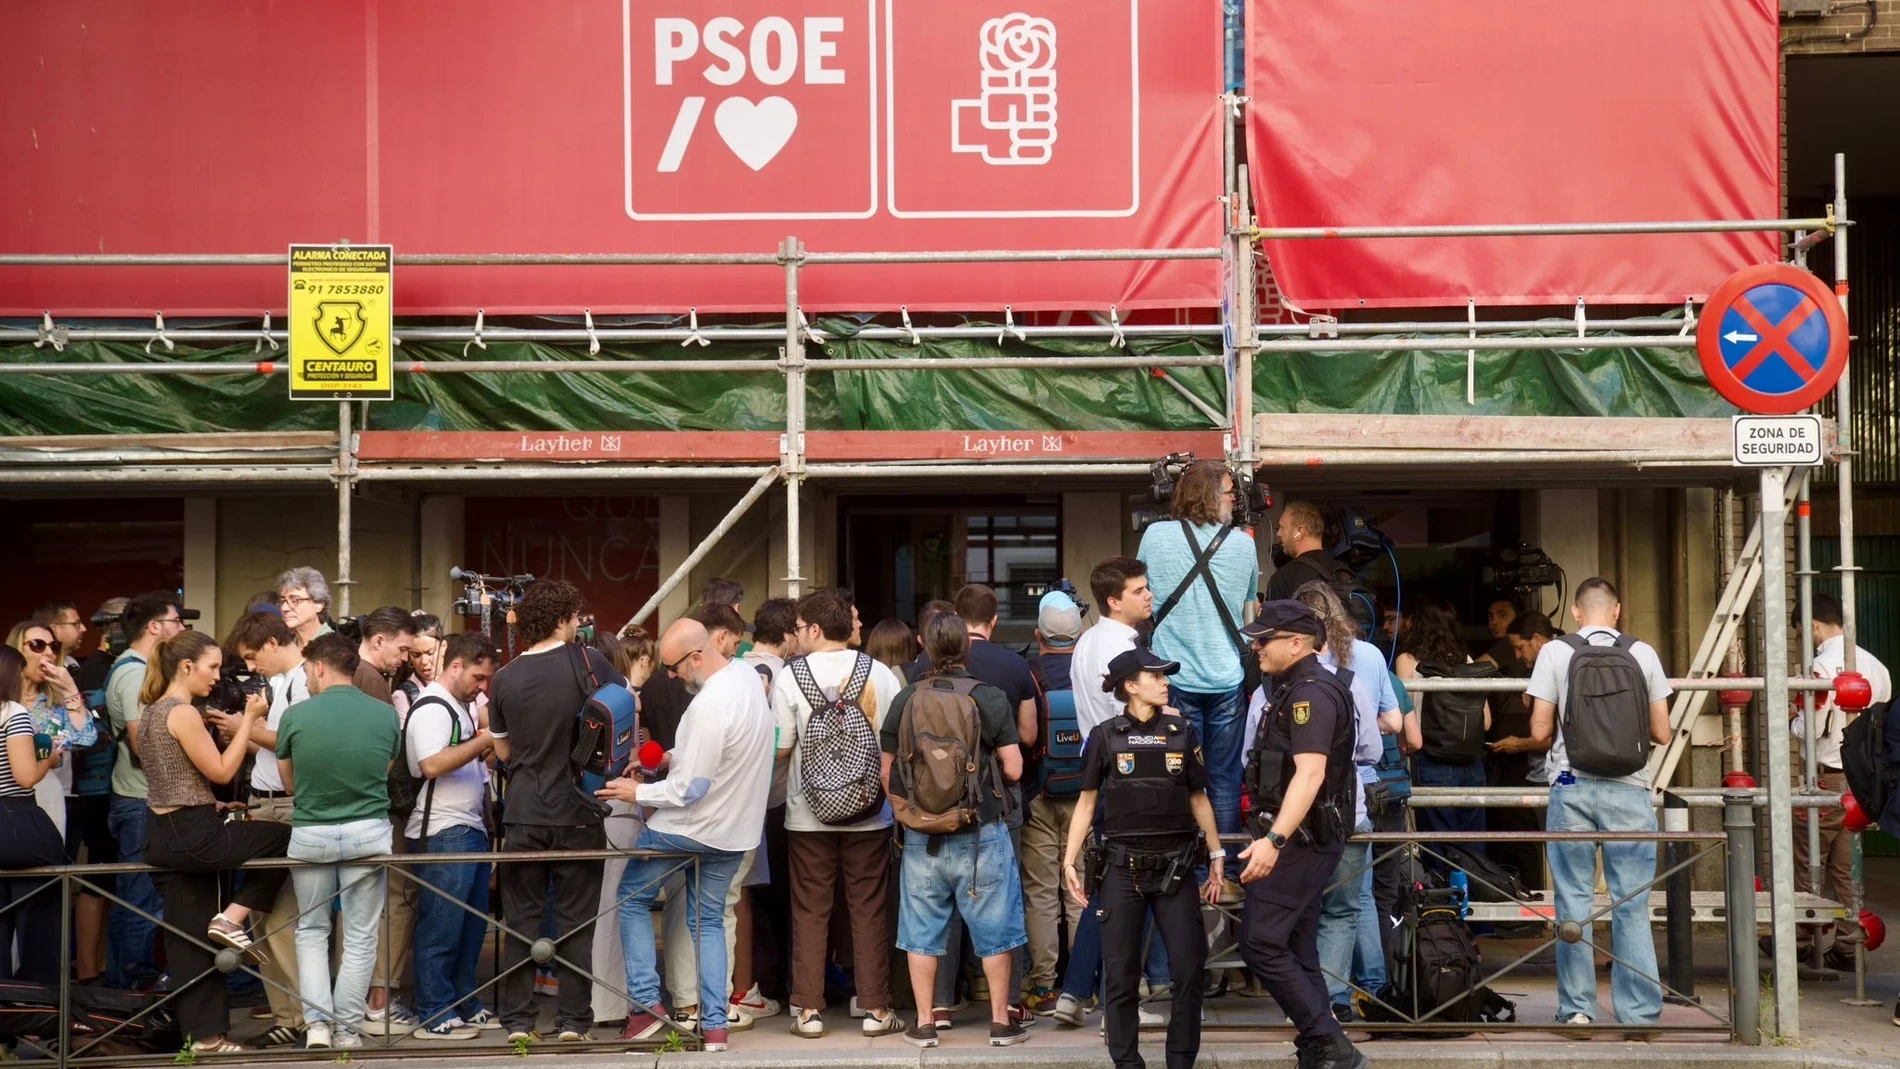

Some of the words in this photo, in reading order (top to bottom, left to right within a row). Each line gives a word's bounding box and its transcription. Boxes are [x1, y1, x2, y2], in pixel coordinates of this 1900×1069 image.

[655, 16, 845, 86] PSOE
[293, 251, 331, 260] ALARMA
[333, 251, 386, 260] CONECTADA
[308, 285, 323, 294] 91
[328, 285, 384, 294] 7853880
[306, 361, 374, 372] CENTAURO
[1749, 428, 1784, 438] ZONA
[1789, 428, 1805, 438] DE
[521, 435, 593, 455] Layher
[963, 435, 1034, 455] Layher
[1742, 443, 1814, 454] SEGURIDAD
[1056, 732, 1079, 742] LiveU
